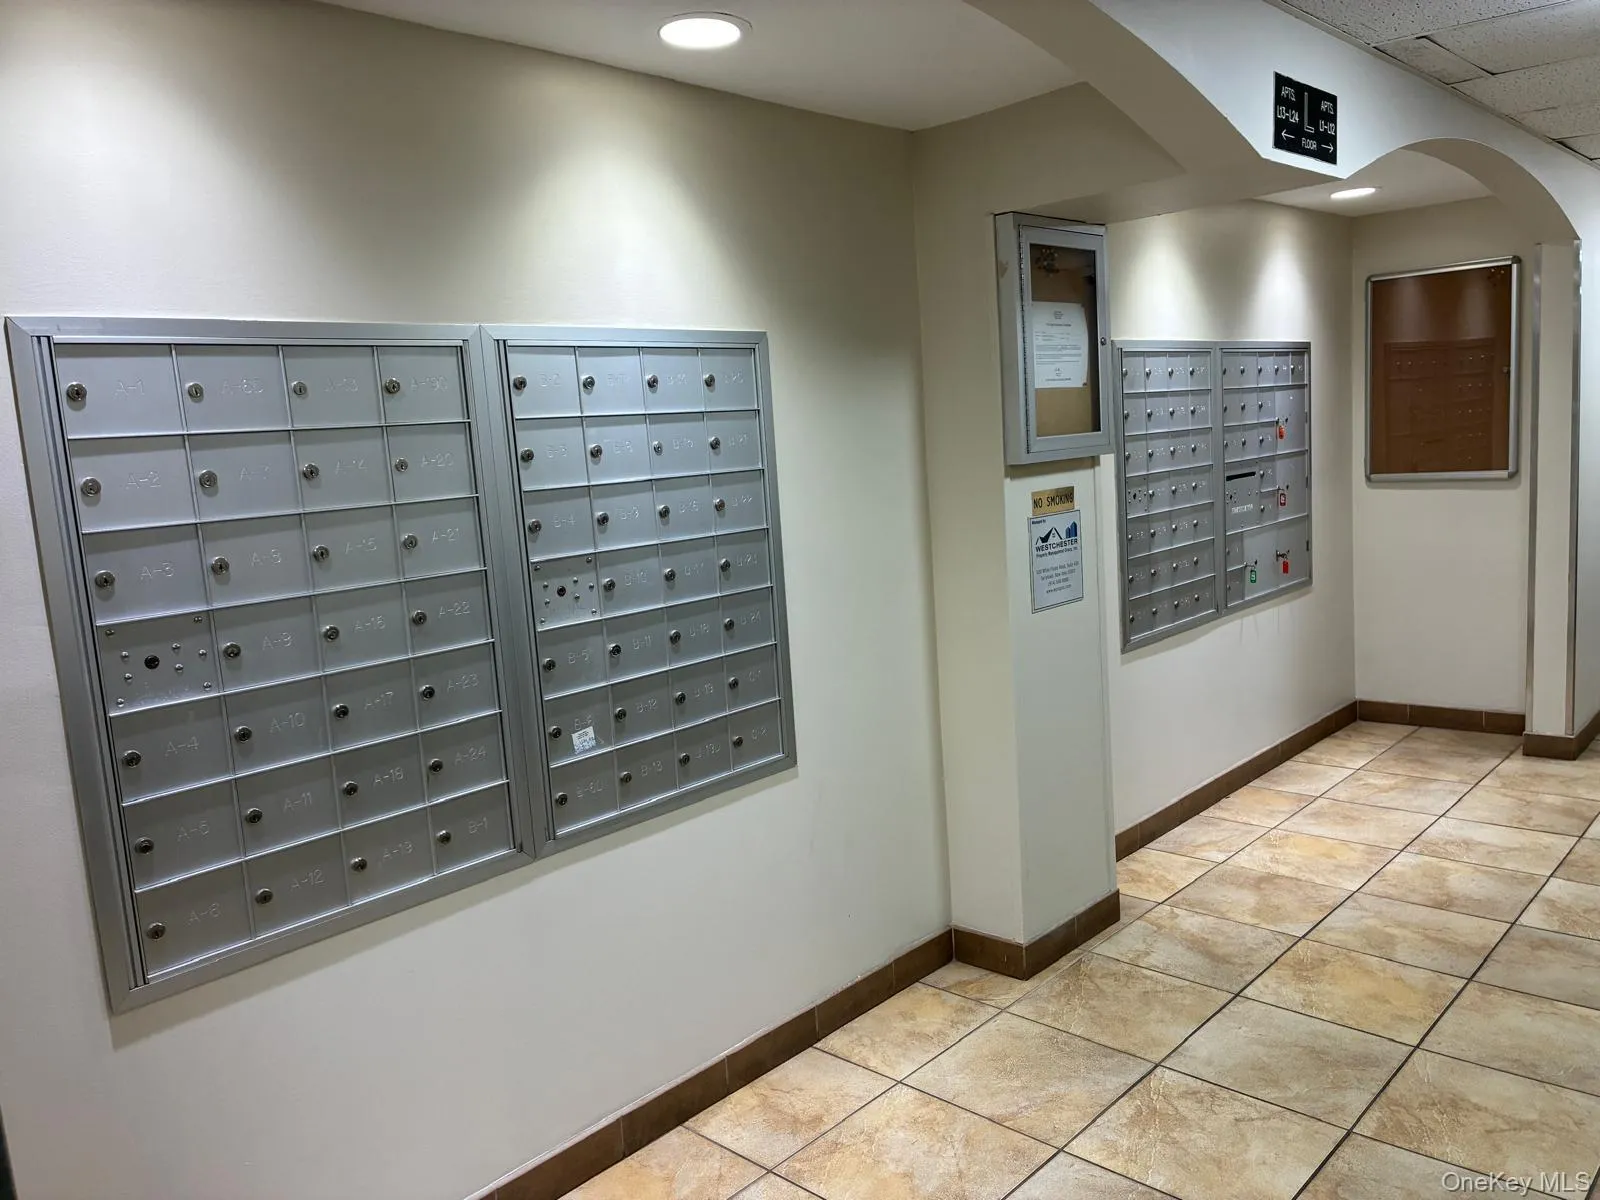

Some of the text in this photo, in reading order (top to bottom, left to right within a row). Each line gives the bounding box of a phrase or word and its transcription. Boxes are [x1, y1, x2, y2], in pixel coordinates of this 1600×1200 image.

[1301, 137, 1317, 151] FLOOR
[112, 377, 145, 399] A-1
[125, 470, 161, 490] A-2
[1033, 492, 1074, 509] NO SMOKING
[1035, 538, 1078, 552] WESTCHESTER
[139, 560, 175, 582] A-3
[438, 600, 471, 618] A-22
[364, 690, 395, 710] A-17
[269, 712, 305, 734] A-10
[164, 735, 199, 756] A-4
[373, 767, 404, 786] A-18
[283, 792, 312, 813] A-11
[468, 815, 488, 834] B-1
[288, 867, 327, 890] A-12
